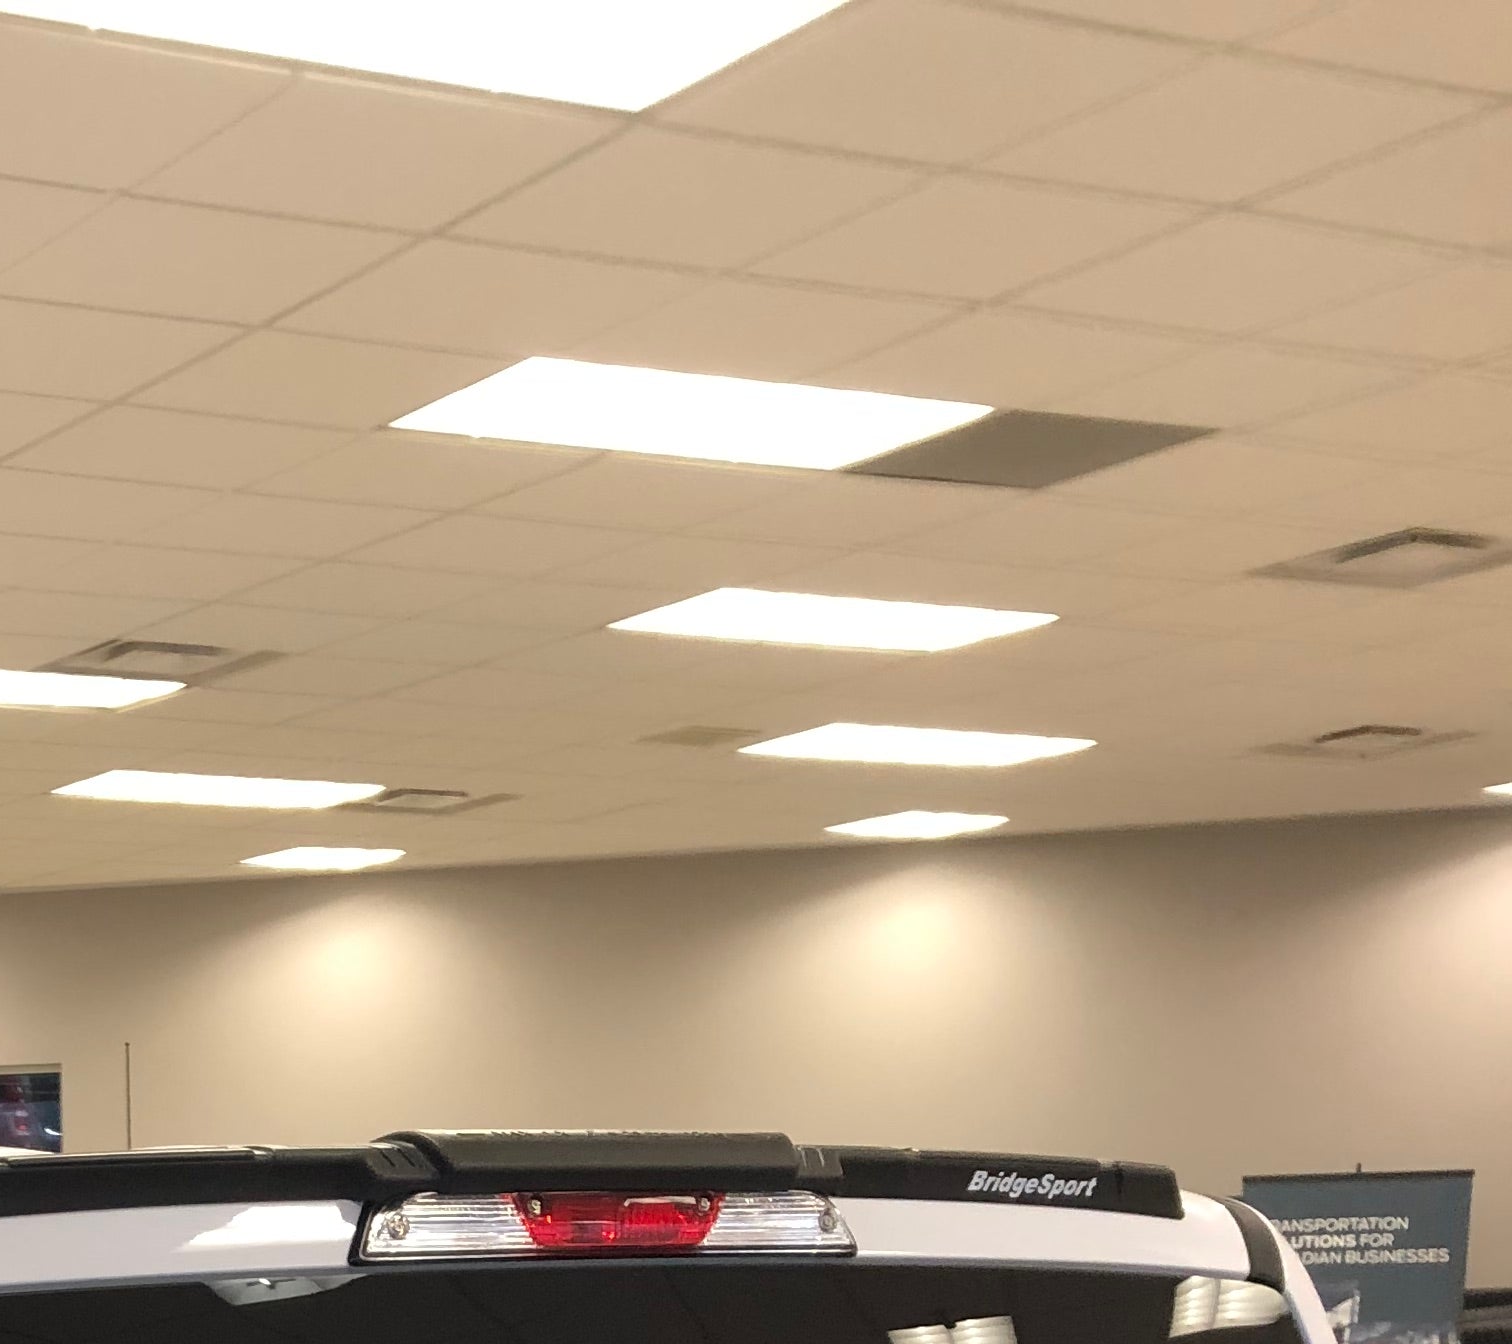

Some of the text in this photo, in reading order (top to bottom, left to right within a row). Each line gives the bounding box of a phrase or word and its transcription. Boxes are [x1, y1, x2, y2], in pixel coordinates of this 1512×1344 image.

[968, 1170, 1097, 1199] BridgeSport
[1269, 1216, 1409, 1233] RANSPORTATION
[1291, 1233, 1394, 1248] UTIONS FOR
[1302, 1248, 1449, 1265] DIAN BUSINESSES
